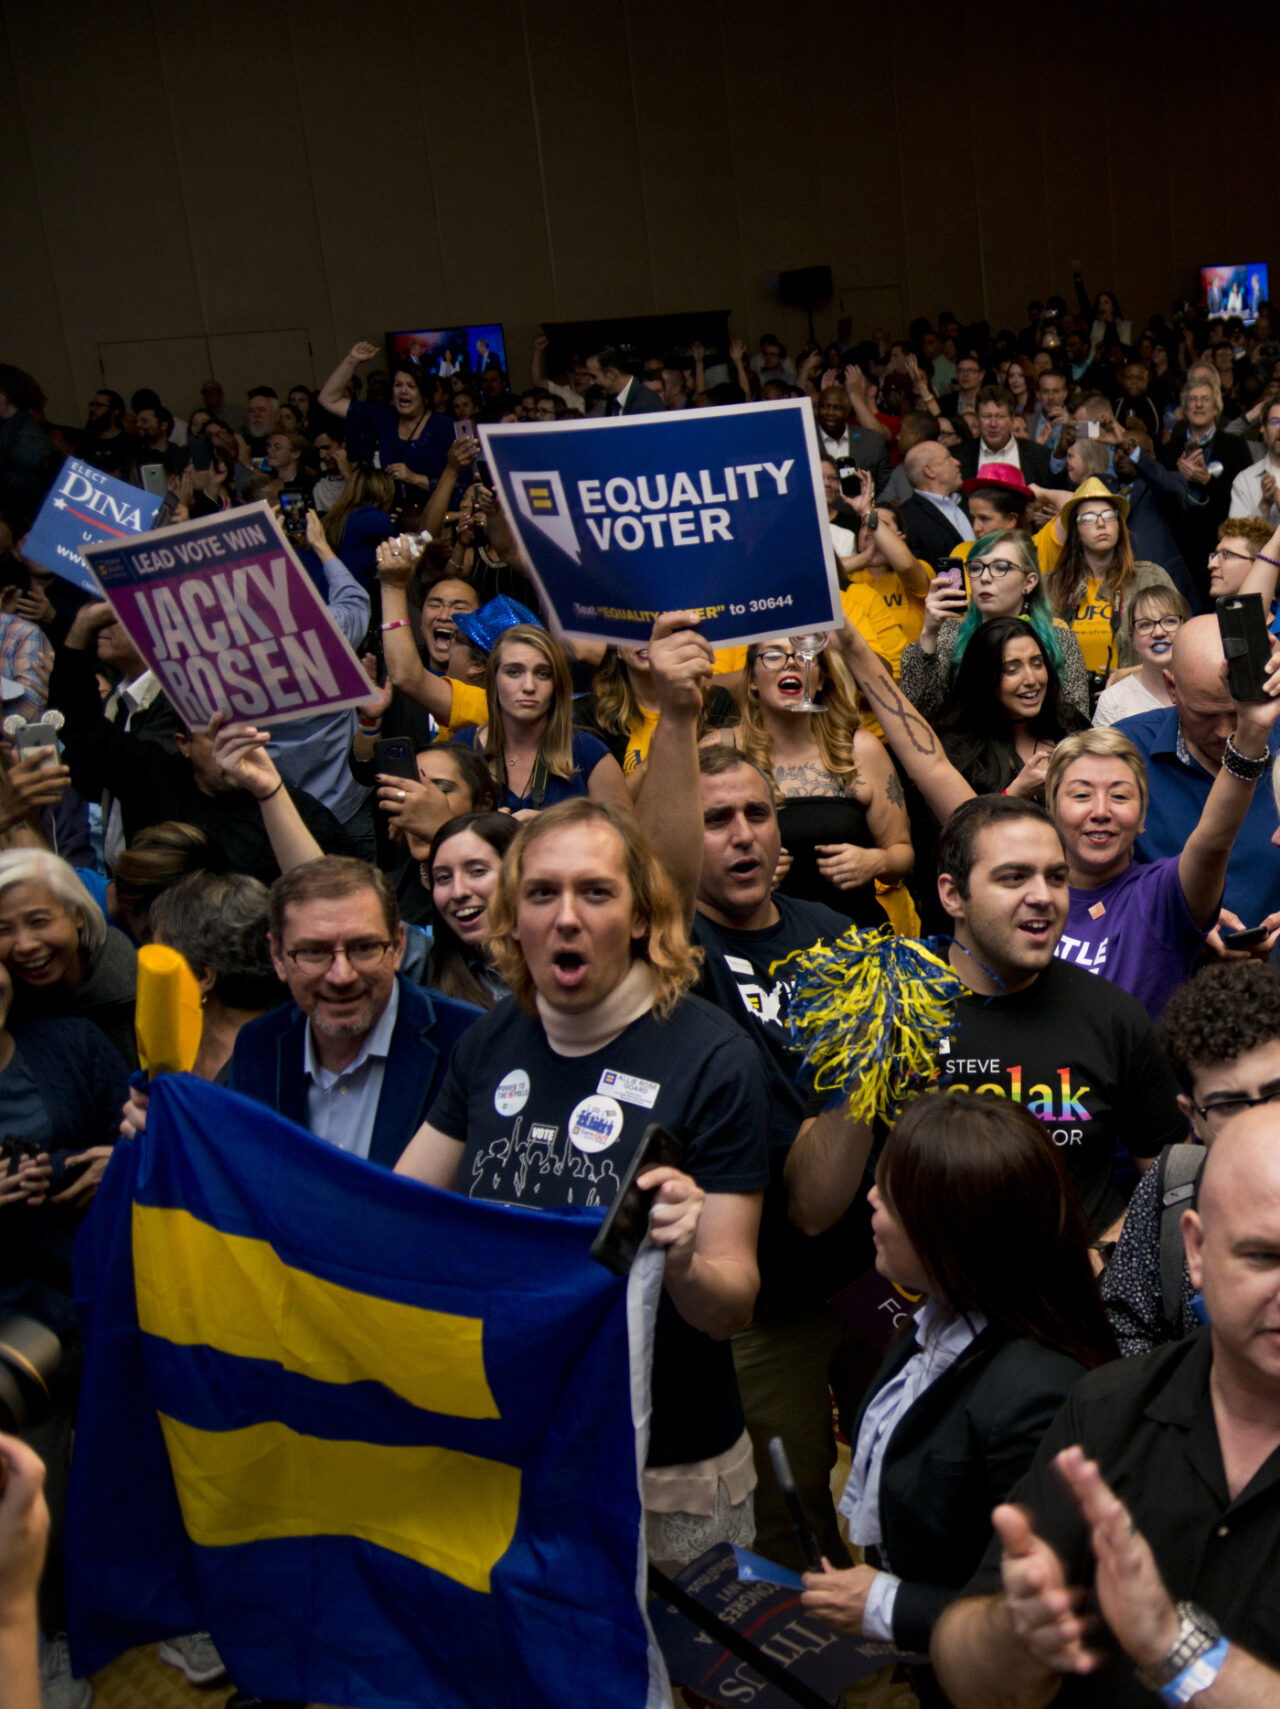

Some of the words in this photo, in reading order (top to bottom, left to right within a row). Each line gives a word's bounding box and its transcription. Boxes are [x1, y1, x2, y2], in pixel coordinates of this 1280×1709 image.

[71, 461, 108, 485] ELECT
[576, 459, 796, 515] EQUALITY
[57, 471, 143, 532] DINA
[132, 551, 176, 577] LEAD
[177, 538, 225, 566] VOTE
[226, 524, 267, 549] WIN
[585, 507, 735, 551] VOTER
[133, 557, 299, 661] JACKY
[729, 602, 747, 616] to
[748, 594, 794, 613] 30644
[160, 629, 342, 726] ROSEN
[945, 1058, 1001, 1075] STEVE
[532, 1126, 555, 1141] VOTE
